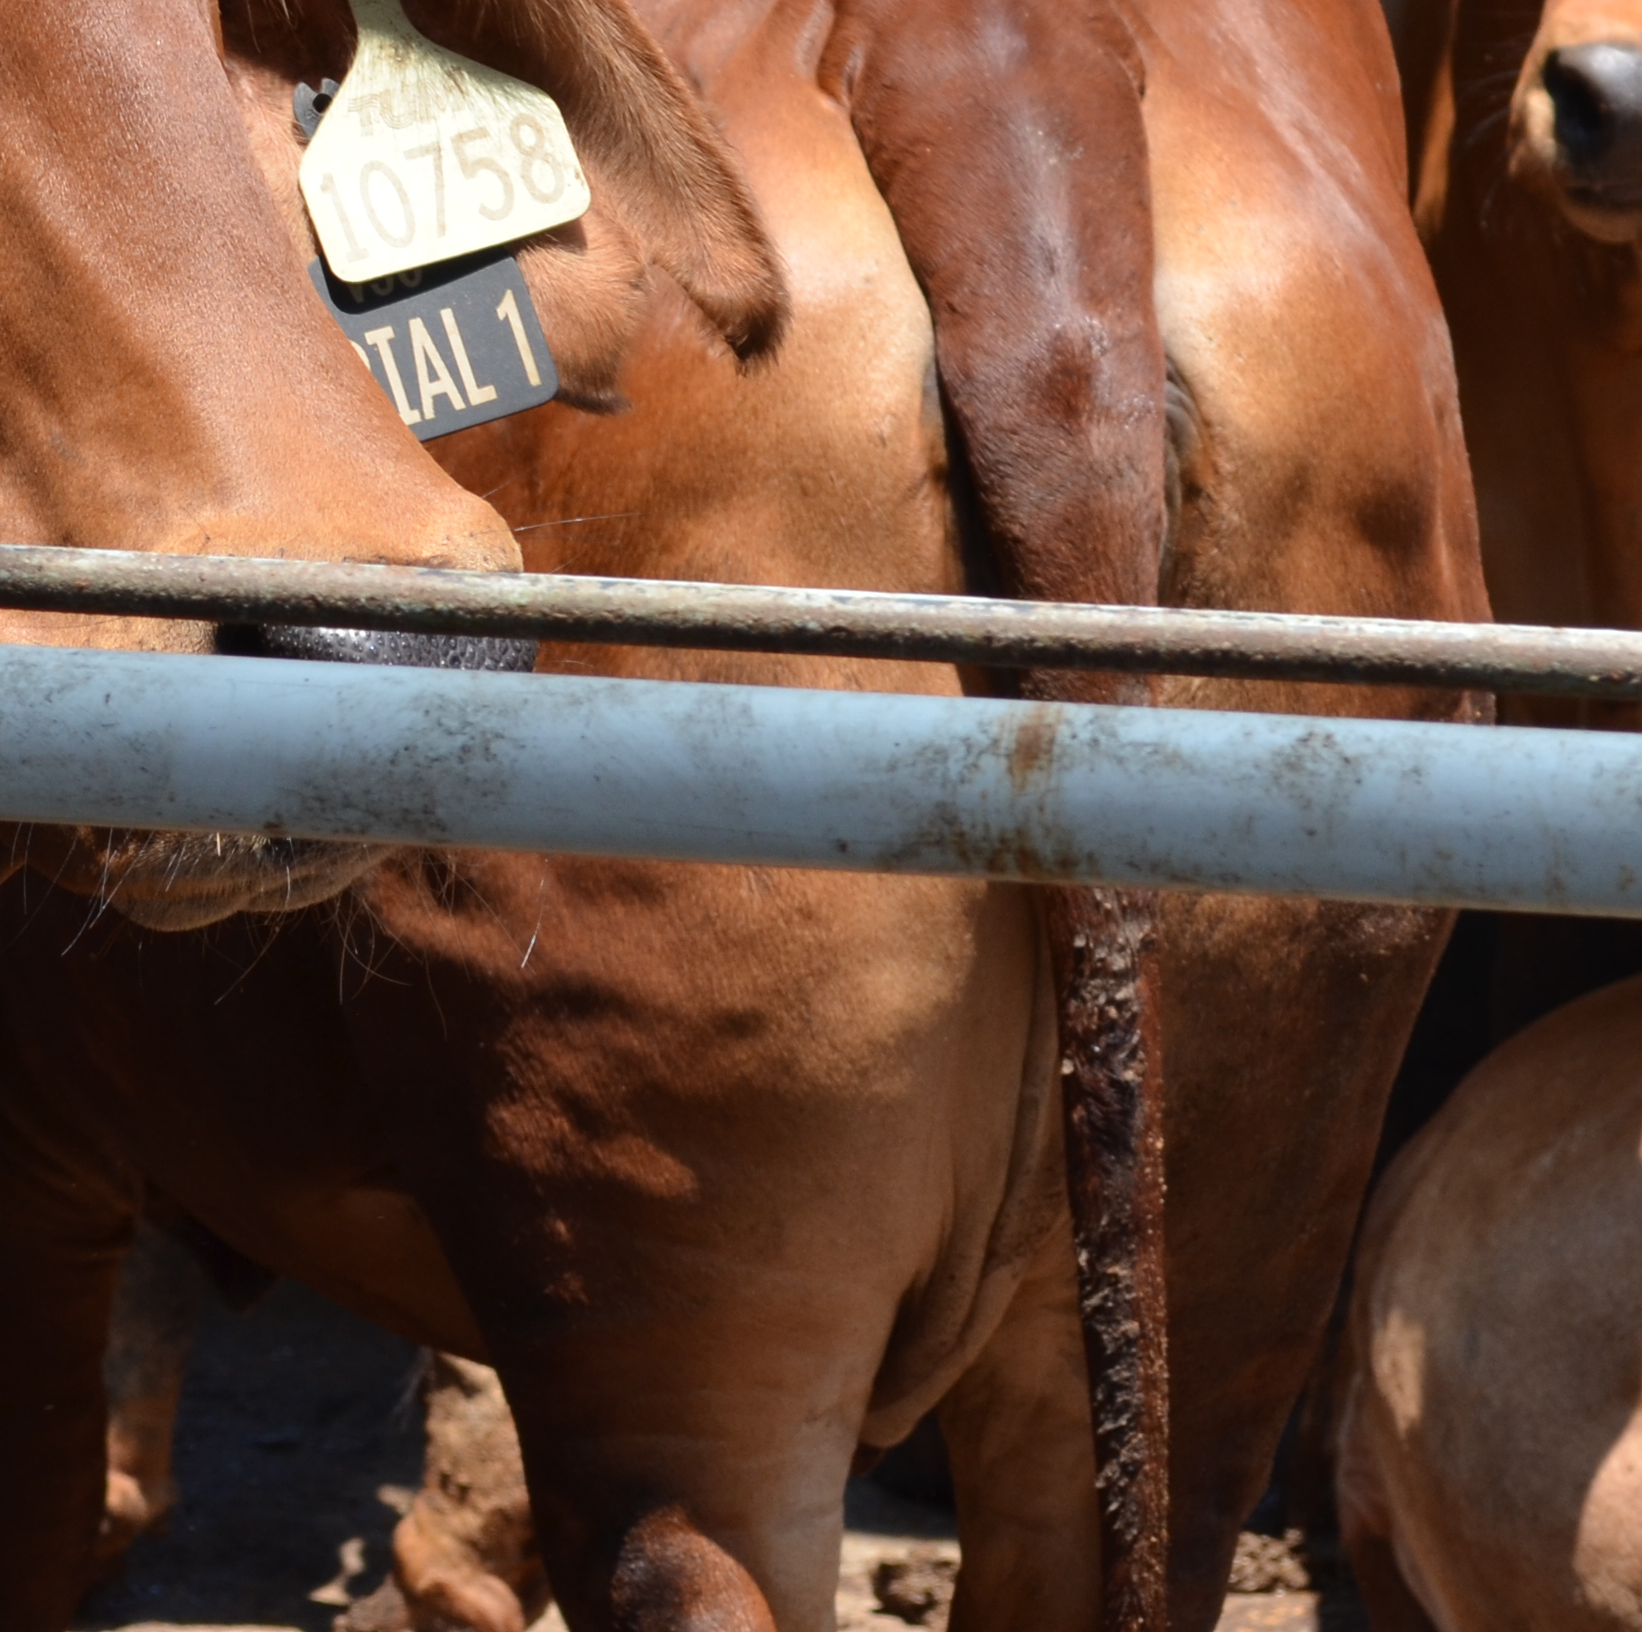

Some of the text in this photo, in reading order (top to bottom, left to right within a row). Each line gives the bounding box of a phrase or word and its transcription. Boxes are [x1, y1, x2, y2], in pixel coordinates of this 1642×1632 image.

[319, 112, 566, 264] 10758
[350, 288, 543, 426] IAL 1
